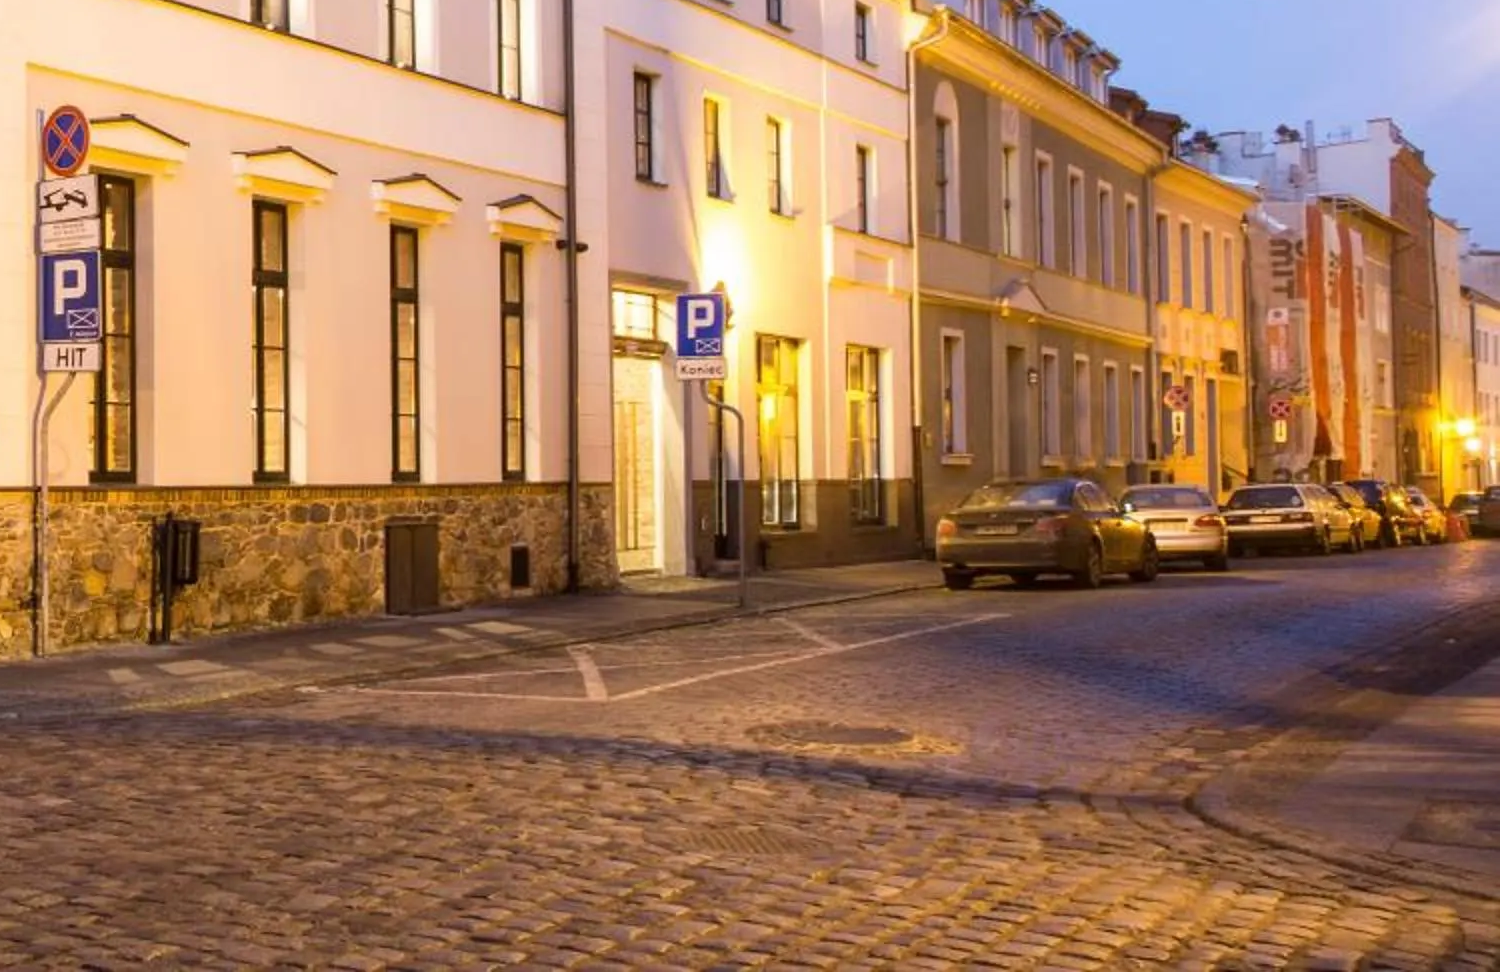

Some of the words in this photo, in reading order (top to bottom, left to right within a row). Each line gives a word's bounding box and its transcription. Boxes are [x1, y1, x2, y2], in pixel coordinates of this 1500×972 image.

[54, 260, 87, 315] P
[687, 300, 715, 340] P
[56, 347, 87, 367] HIT
